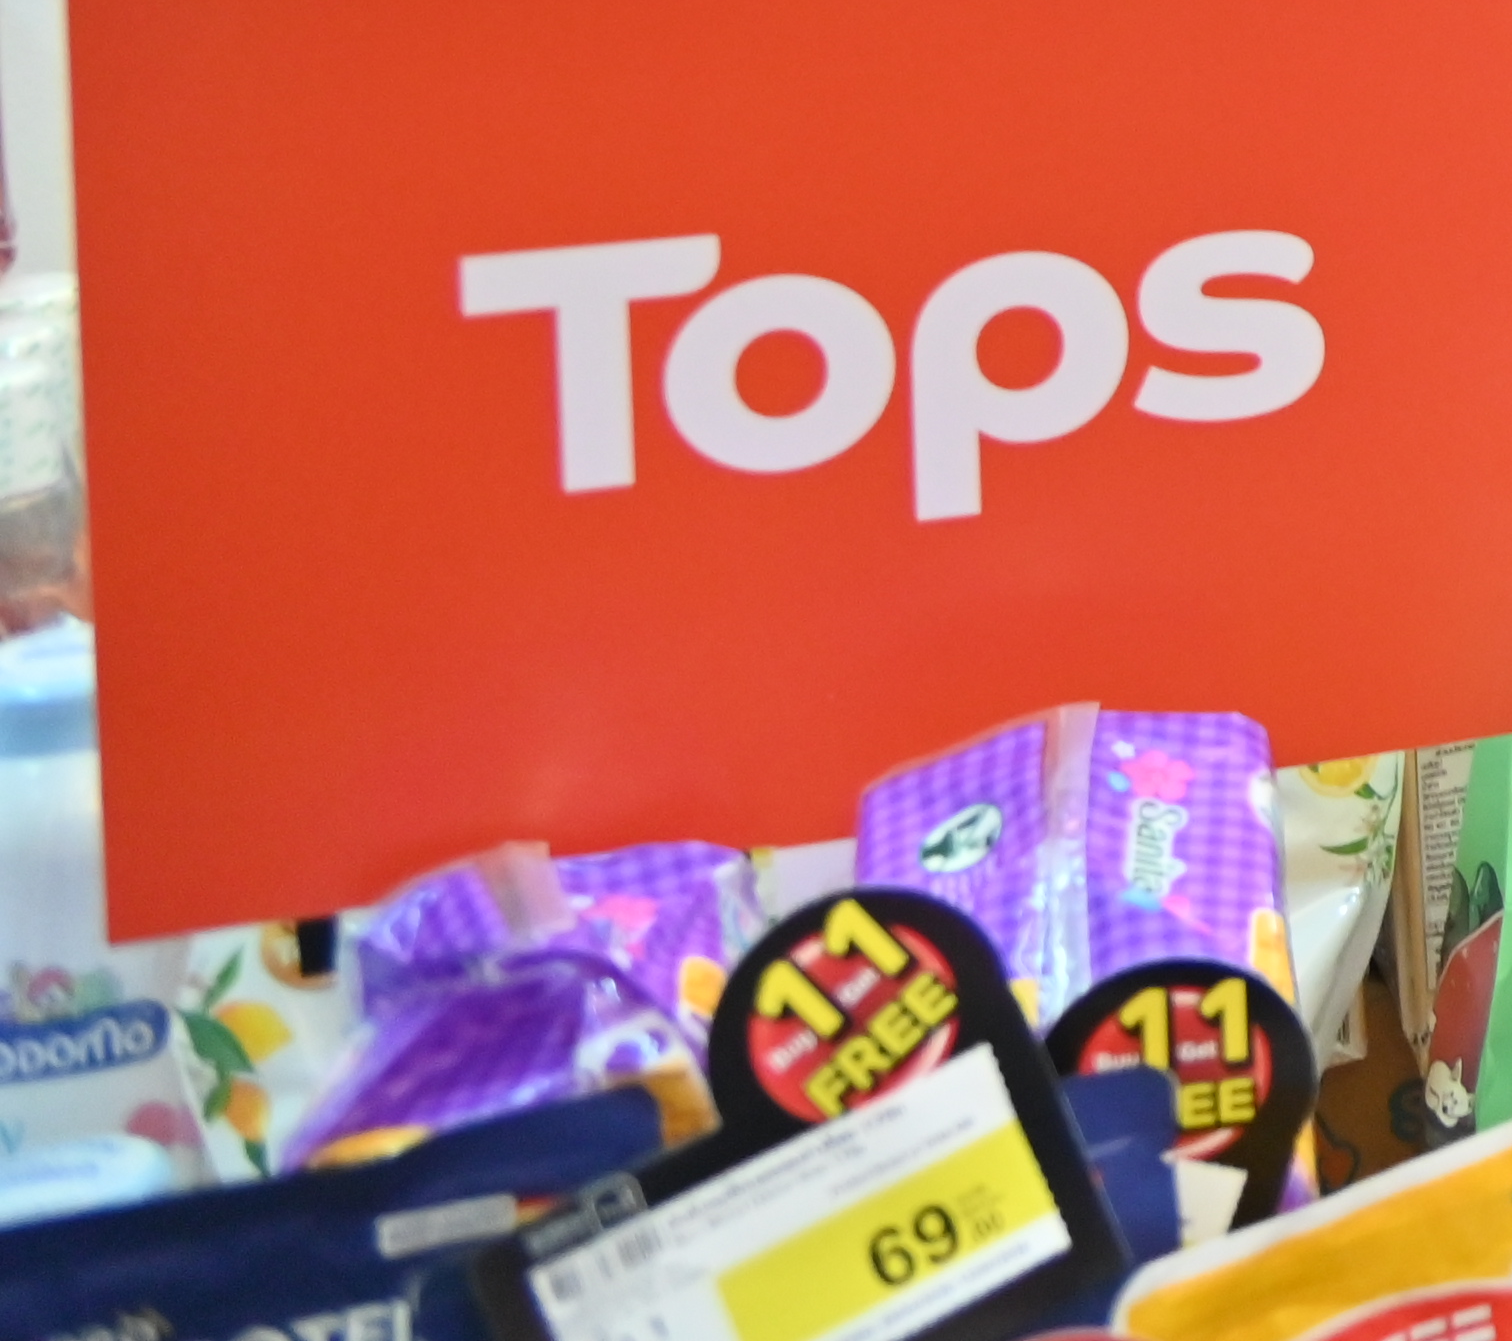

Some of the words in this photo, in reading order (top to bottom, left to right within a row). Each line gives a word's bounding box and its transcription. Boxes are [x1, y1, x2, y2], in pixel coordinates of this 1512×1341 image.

[456, 227, 1328, 524] Tops
[756, 959, 845, 1040] 1
[824, 896, 910, 978] 1
[1119, 986, 1170, 1070] 1
[1201, 977, 1250, 1063] 1
[804, 969, 960, 1121] FREE
[1176, 1077, 1257, 1130] EE
[866, 1203, 960, 1289] 69
